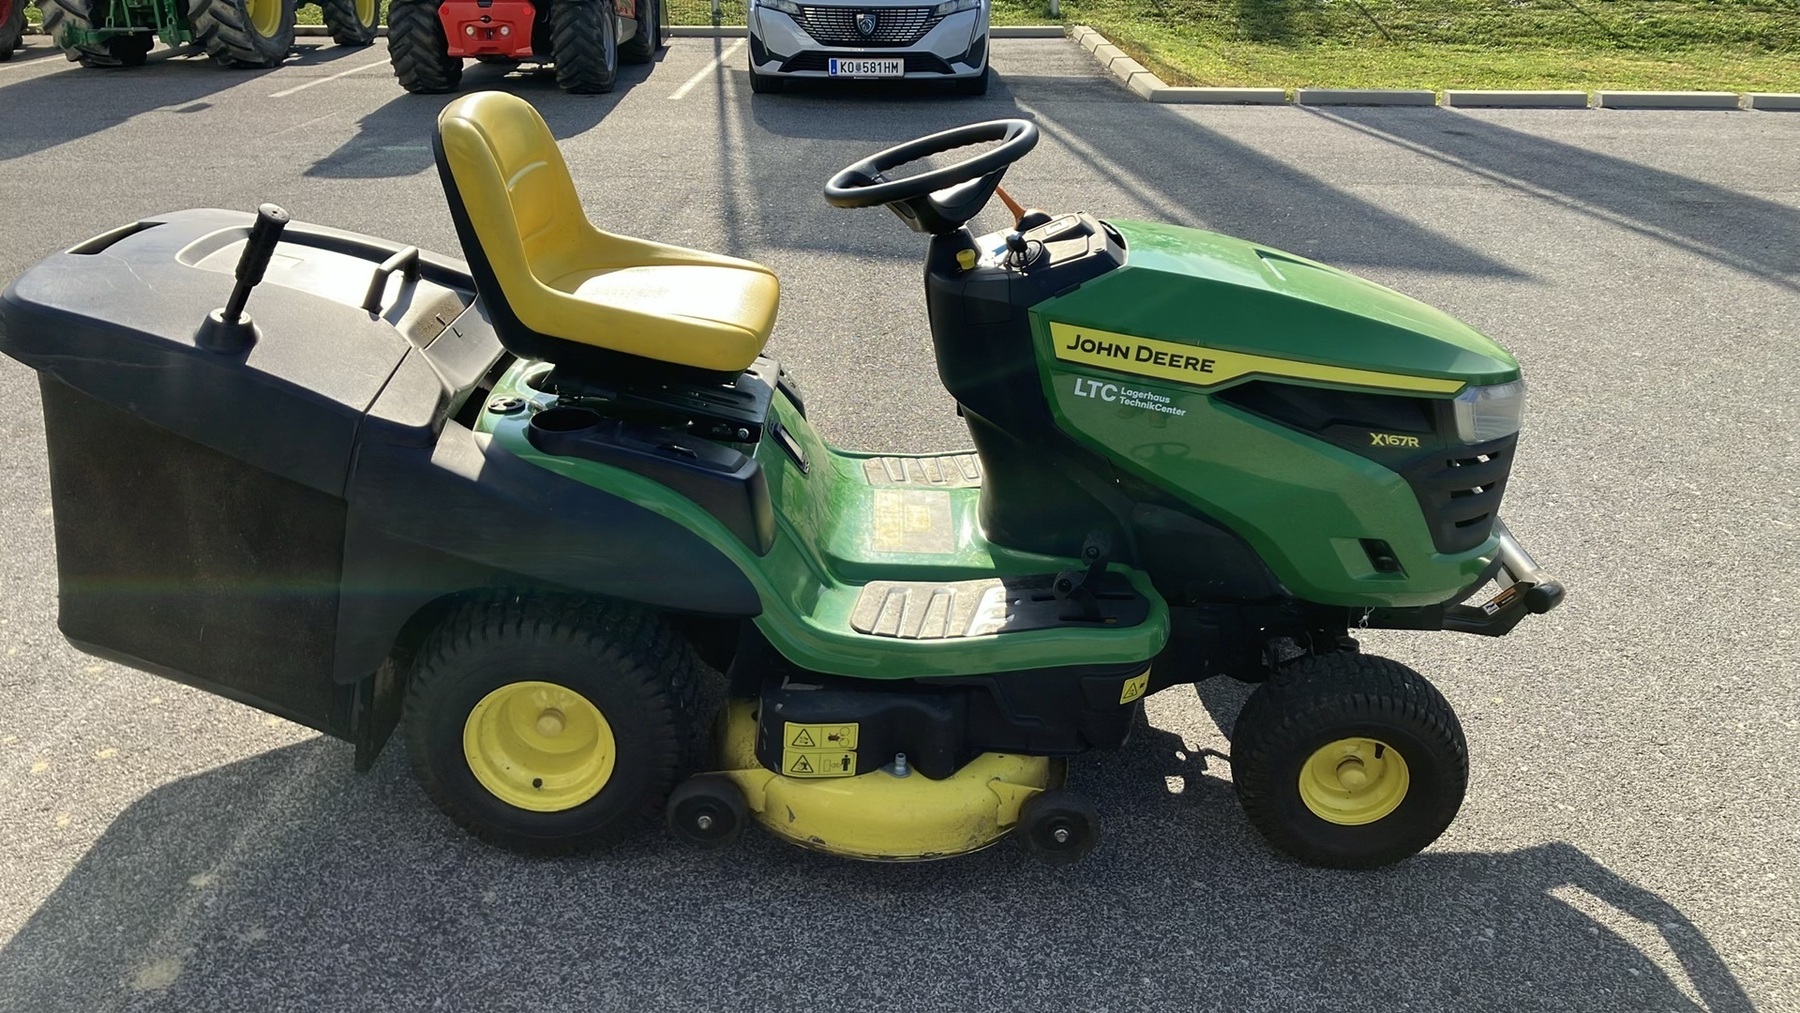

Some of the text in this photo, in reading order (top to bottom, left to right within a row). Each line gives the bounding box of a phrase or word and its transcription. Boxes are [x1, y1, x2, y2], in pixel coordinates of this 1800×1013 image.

[840, 61, 854, 74] KO
[862, 61, 899, 74] 581HM
[1066, 334, 1216, 374] JOHN DEERE
[1074, 378, 1119, 402] LTC
[1120, 387, 1171, 404] Lagerhaus
[1119, 396, 1187, 417] TechnikCenter
[1369, 432, 1420, 448] X167R
